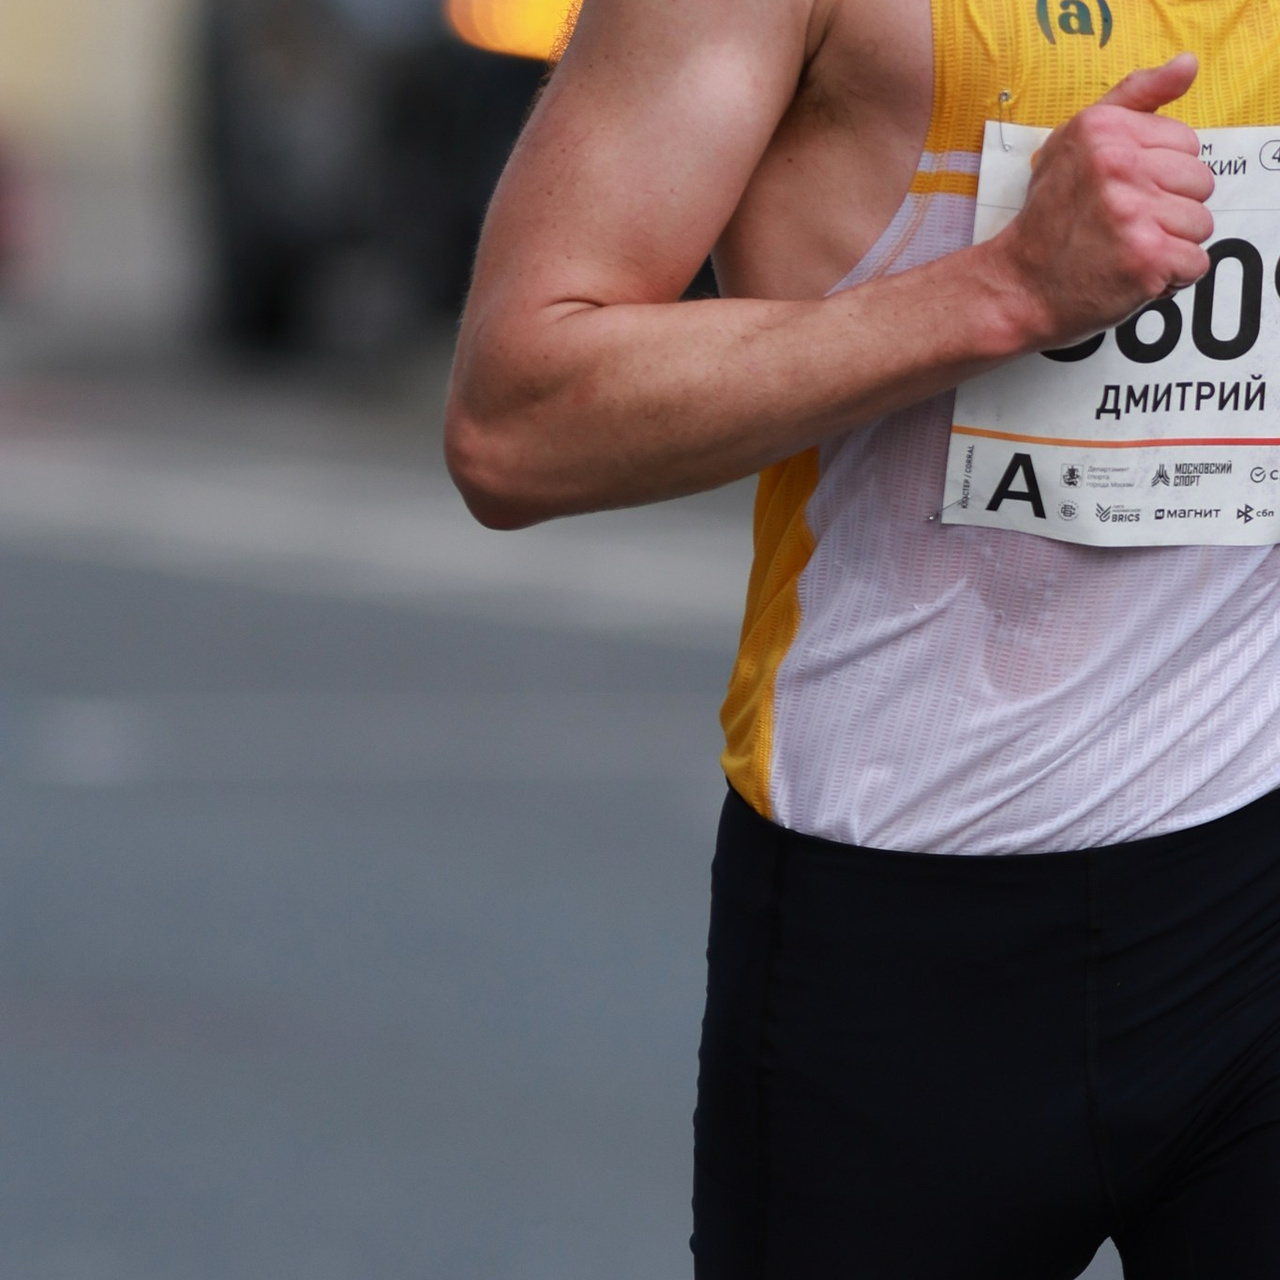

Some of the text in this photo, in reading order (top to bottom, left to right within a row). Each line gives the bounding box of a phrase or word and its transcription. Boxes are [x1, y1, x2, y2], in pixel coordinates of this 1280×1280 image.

[1095, 374, 1267, 420] ДМИТРИЙ
[1174, 460, 1232, 474] МОСКОВСКИЙ
[1173, 475, 1201, 487] СПОРТ
[1111, 513, 1140, 522] BRICS
[1255, 509, 1275, 517] сбп
